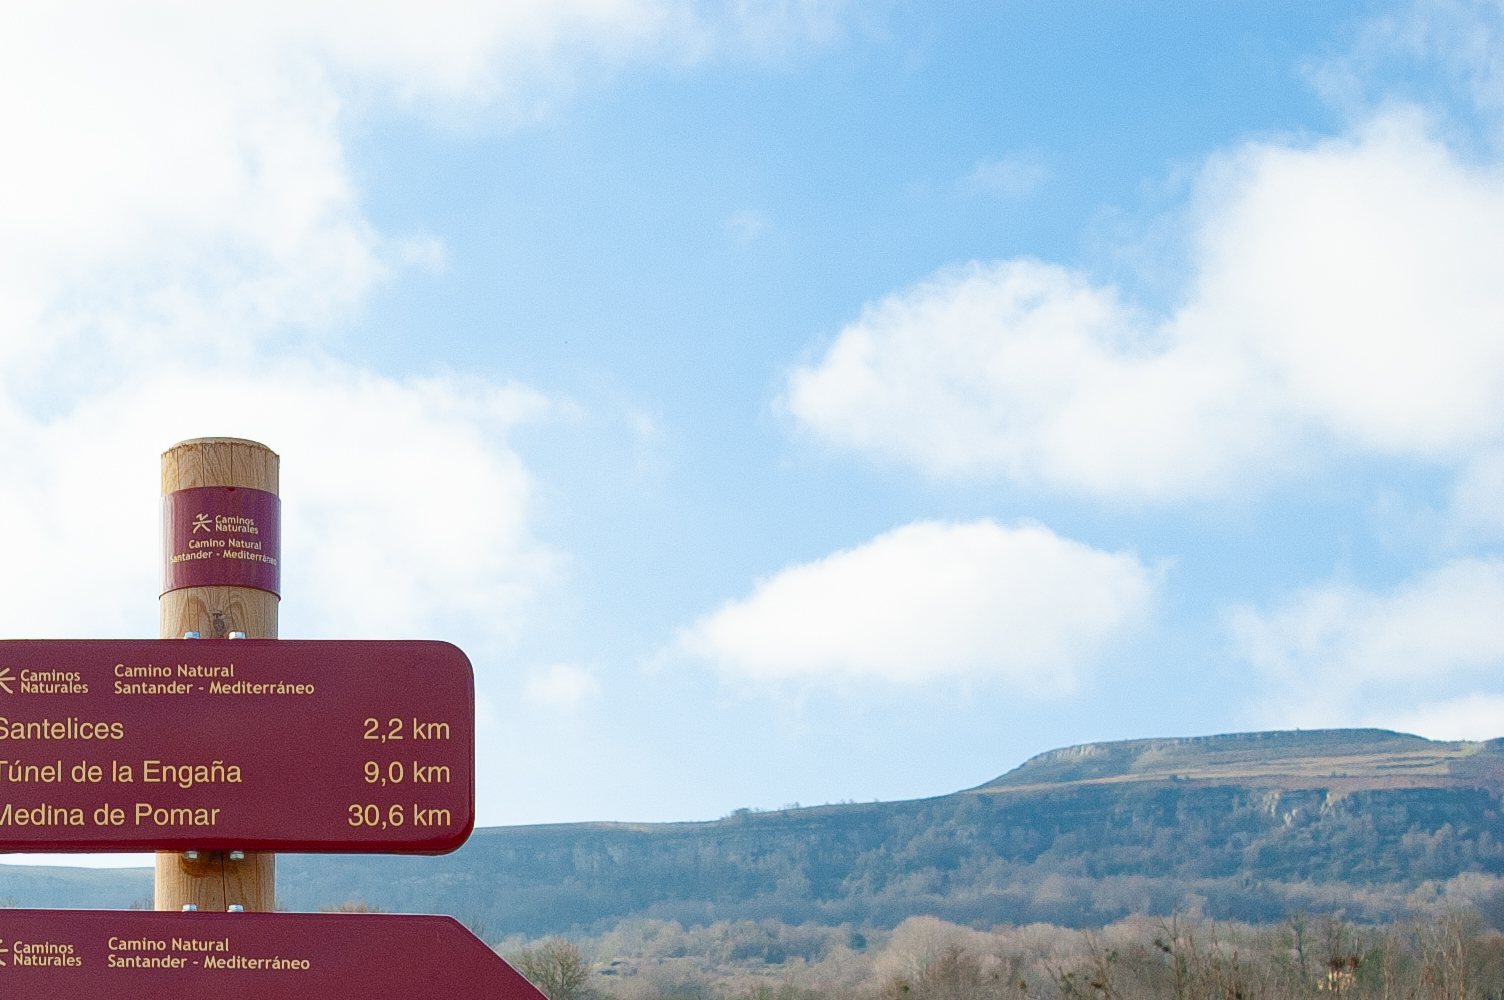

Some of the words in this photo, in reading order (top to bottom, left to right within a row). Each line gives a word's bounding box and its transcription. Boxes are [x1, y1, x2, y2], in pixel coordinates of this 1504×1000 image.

[215, 515, 254, 525] Caminos
[215, 524, 259, 535] Naturales
[188, 538, 225, 549] Camino
[228, 538, 262, 550] Natural
[169, 550, 213, 564] Santander
[20, 668, 81, 683] Caminos
[114, 663, 172, 678] Camino
[177, 663, 234, 678] Natural
[20, 679, 89, 694] Naturales
[114, 680, 194, 695] Santander
[209, 680, 315, 695] Mediterráneo
[363, 717, 404, 744] 2,2
[413, 717, 450, 740] km
[70, 760, 103, 783] de
[112, 760, 134, 783] la
[143, 760, 243, 789] Engaña
[364, 760, 404, 787] 9,0
[413, 760, 450, 783] km
[93, 803, 125, 826] de
[135, 803, 221, 826] Pomar
[348, 804, 404, 830] 30,6
[413, 803, 451, 826] km
[13, 940, 74, 956] Caminos
[108, 936, 167, 951] Camino
[171, 937, 229, 952] Natural
[13, 952, 82, 967] Naturales
[107, 953, 188, 969] Santander
[203, 955, 311, 970] Mediterráneo
